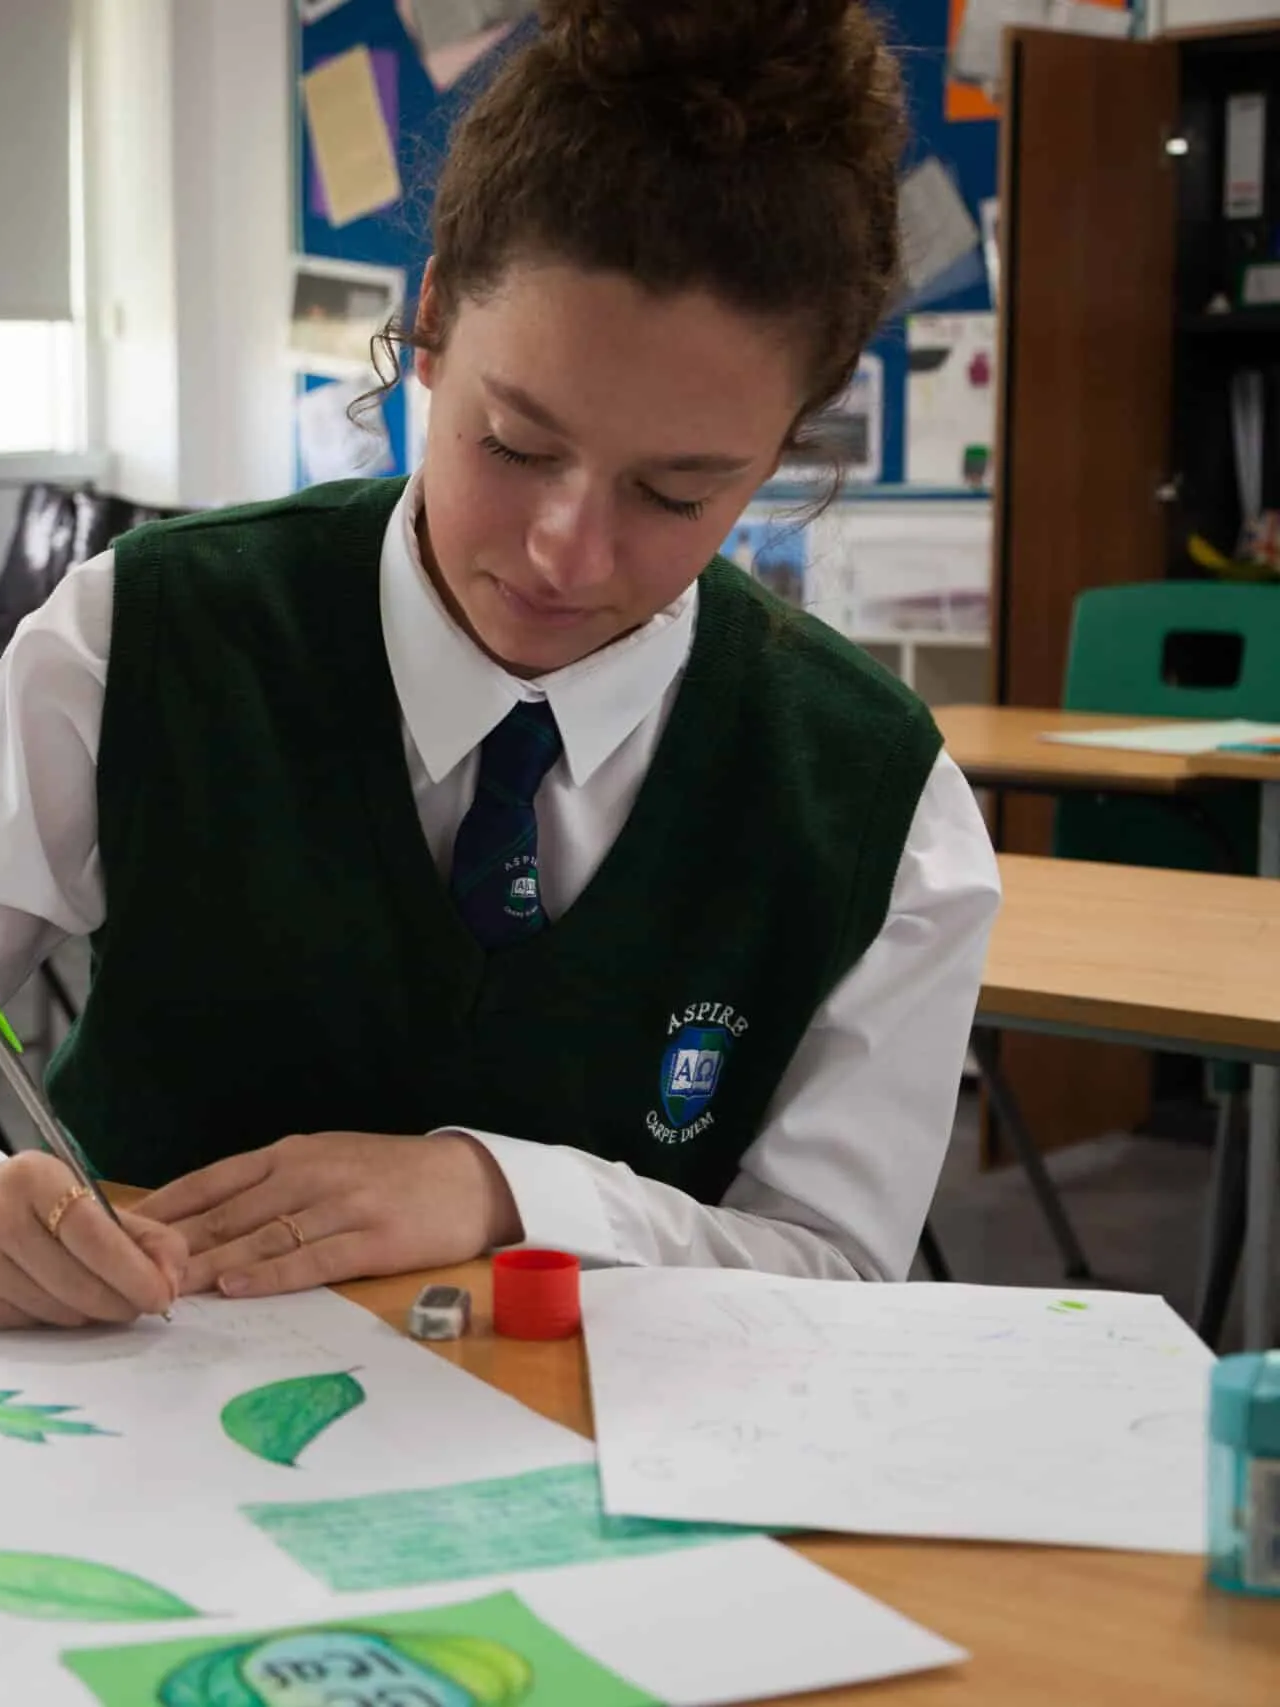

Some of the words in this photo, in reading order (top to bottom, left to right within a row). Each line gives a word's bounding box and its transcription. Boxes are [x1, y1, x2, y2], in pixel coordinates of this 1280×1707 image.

[667, 1002, 748, 1037] ASPIRE
[646, 1110, 678, 1144] CARPE
[681, 1111, 714, 1143] DIEM
